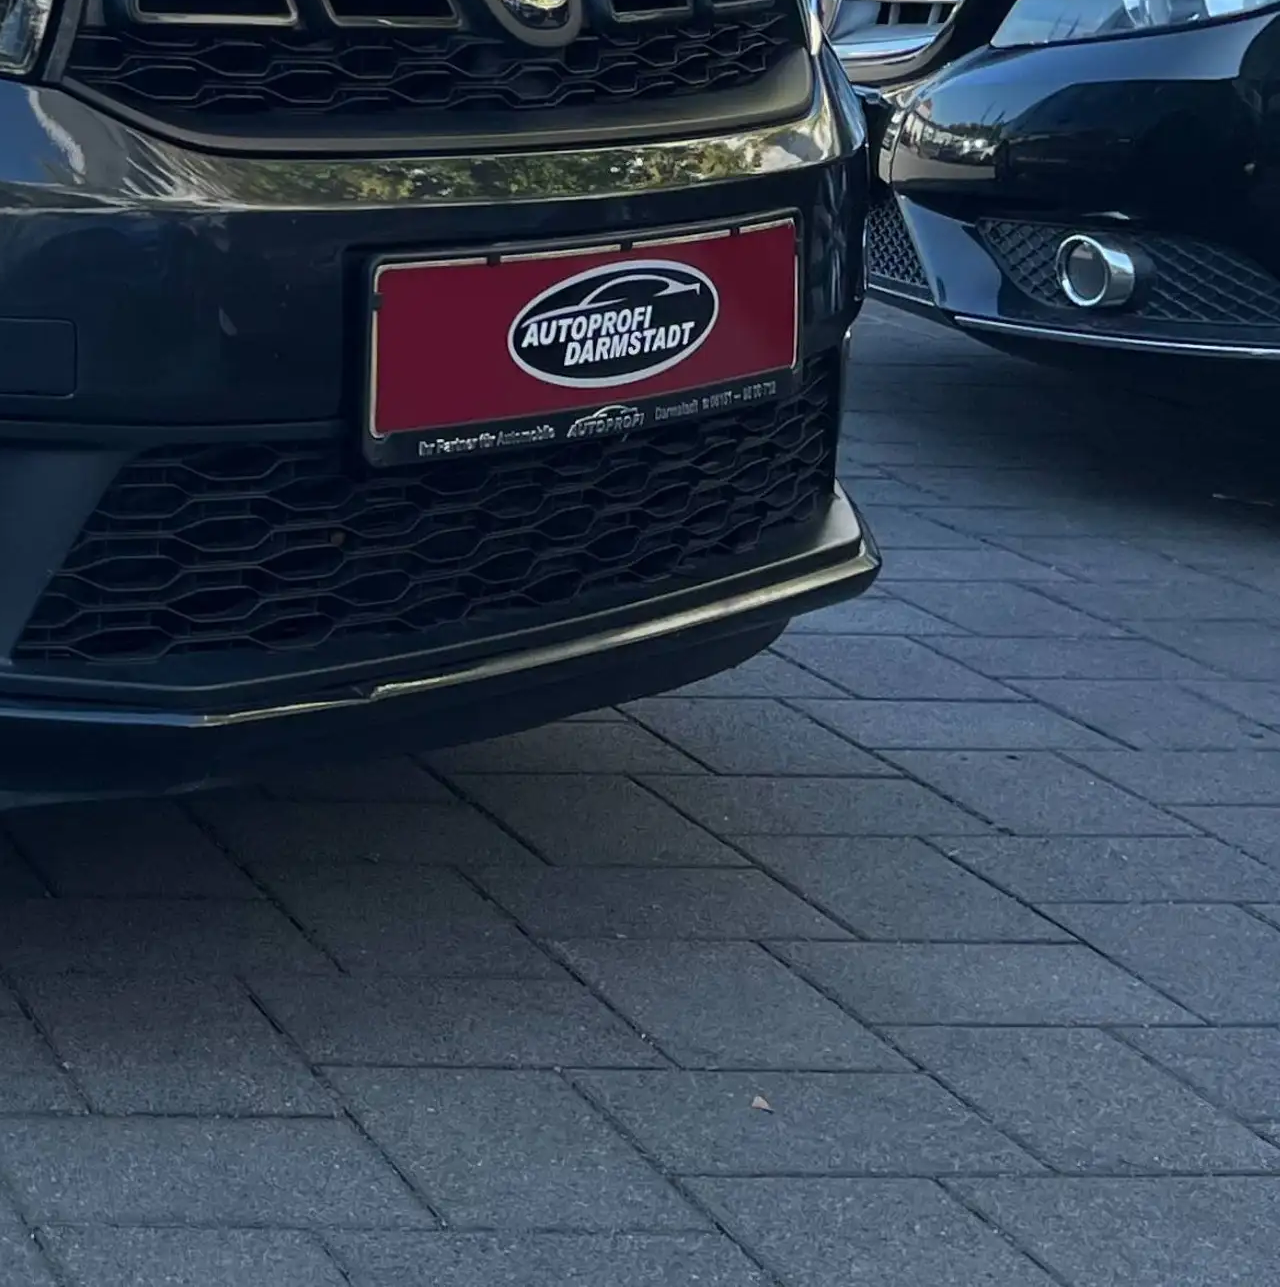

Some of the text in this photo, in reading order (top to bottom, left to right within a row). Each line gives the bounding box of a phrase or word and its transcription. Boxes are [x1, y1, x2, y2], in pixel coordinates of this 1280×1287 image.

[521, 305, 653, 348] AUTOPROFI
[563, 321, 696, 367] DARMSTADT
[566, 412, 644, 438] AUTOPROFI
